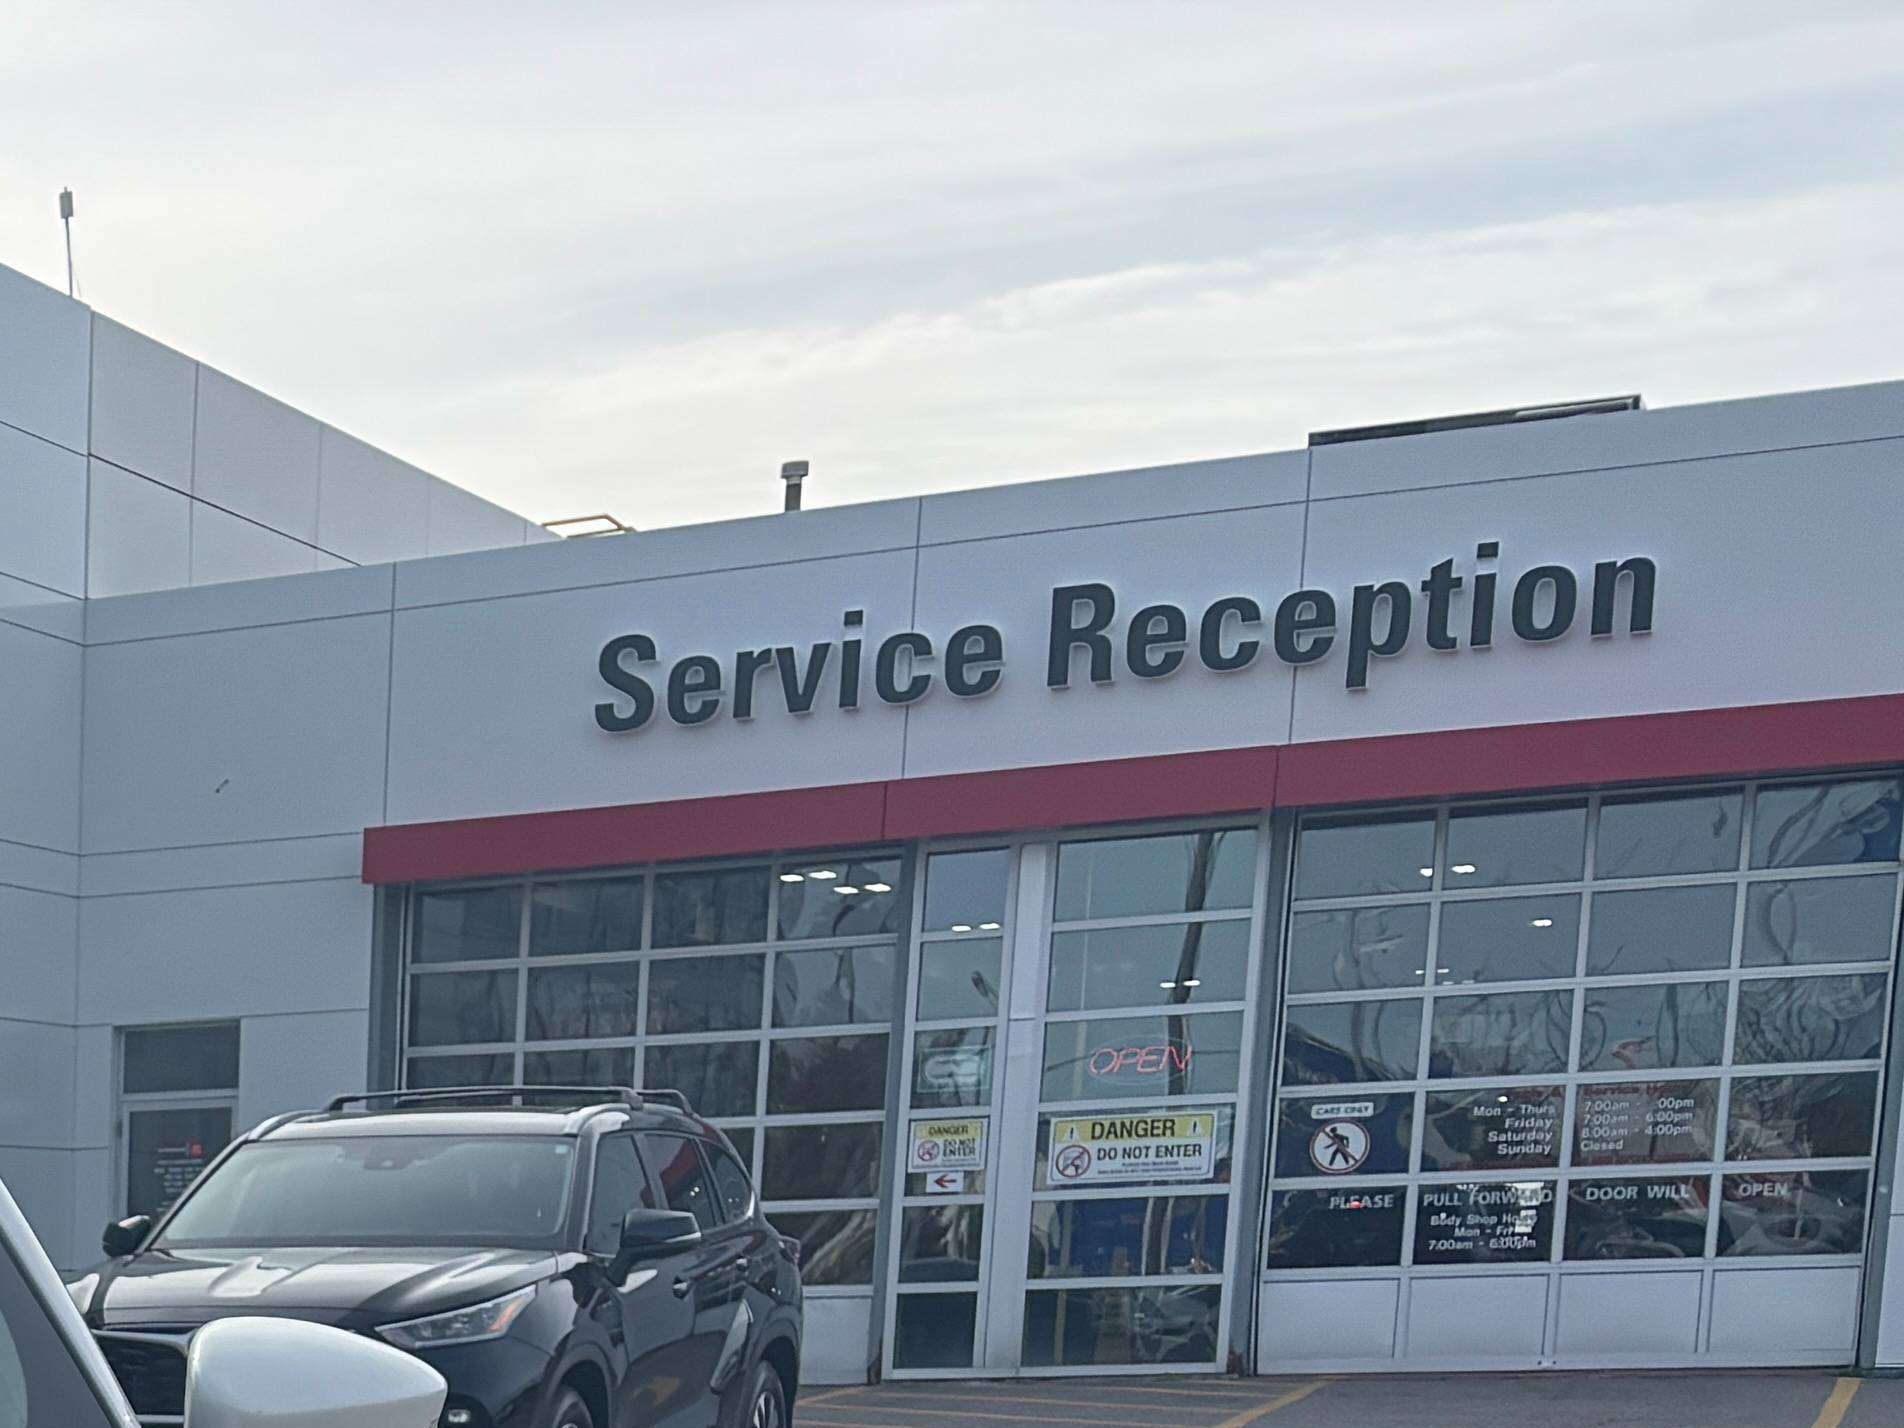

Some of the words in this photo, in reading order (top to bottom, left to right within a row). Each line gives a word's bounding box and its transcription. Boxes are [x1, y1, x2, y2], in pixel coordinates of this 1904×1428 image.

[593, 608, 1003, 734] Service
[1046, 541, 1658, 690] Reception
[1090, 1045, 1193, 1075] OPEN
[1473, 1105, 1501, 1117] Mon
[928, 1124, 969, 1137] DANGER
[1091, 1118, 1176, 1140] DANGER
[1504, 1117, 1554, 1129] Friday
[1488, 1129, 1553, 1143] Saturday
[1096, 1147, 1118, 1161] DO
[1122, 1145, 1151, 1160] NOT
[1155, 1143, 1202, 1158] ENTER
[1497, 1142, 1553, 1156] Sunday
[1580, 1138, 1624, 1151] Closed
[1423, 1192, 1463, 1207] PULL
[1586, 1185, 1638, 1201] DOOR
[1647, 1183, 1691, 1199] WILL
[1739, 1182, 1790, 1198] OPEN
[1466, 1213, 1498, 1226] Shop
[1453, 1226, 1481, 1238] Mon
